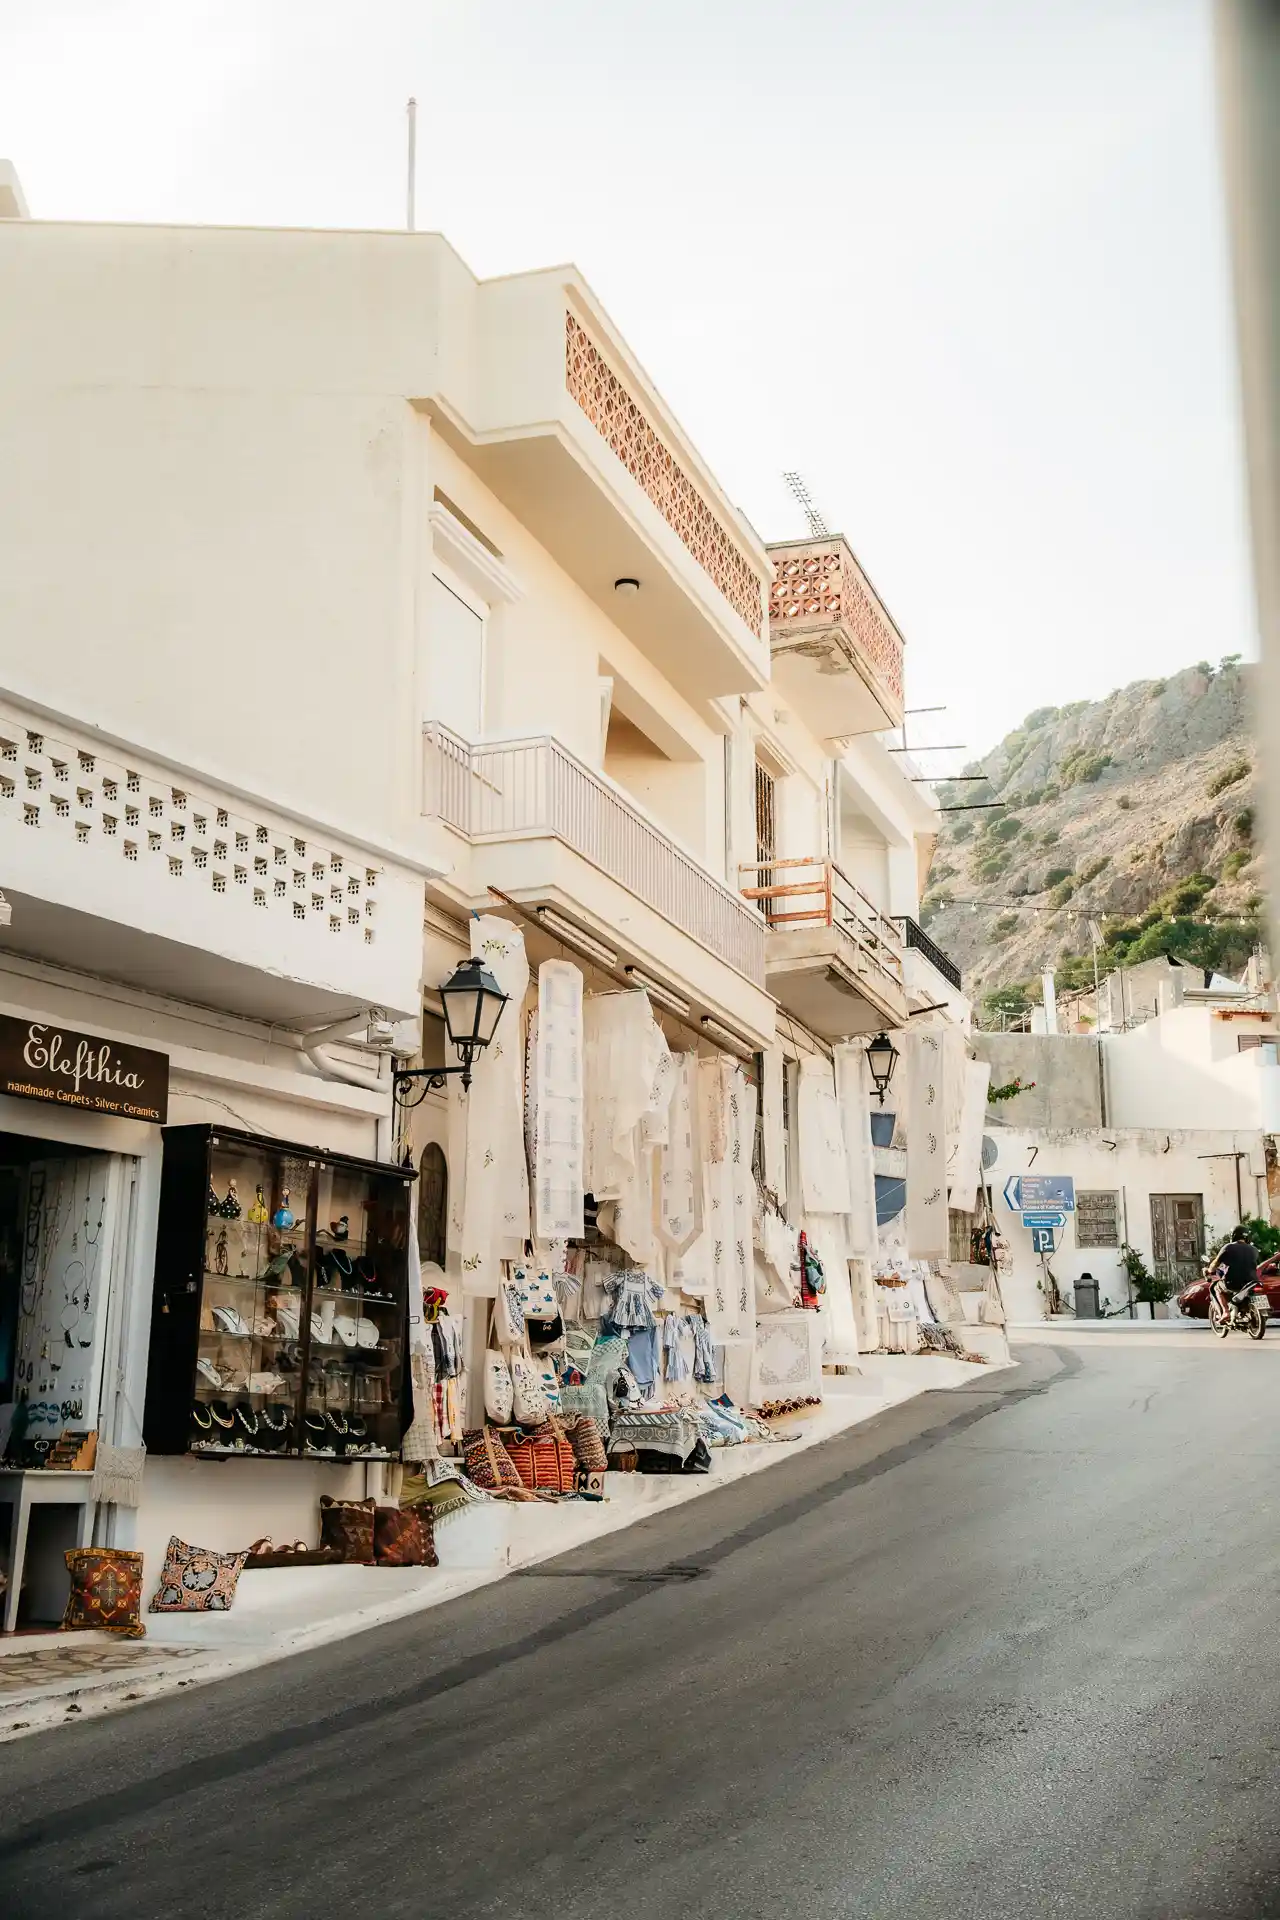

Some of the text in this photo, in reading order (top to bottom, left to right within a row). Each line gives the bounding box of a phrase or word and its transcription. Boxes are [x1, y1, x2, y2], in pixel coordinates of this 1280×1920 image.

[23, 1024, 145, 1092] Elefthia
[56, 1089, 90, 1105] Carpets
[95, 1096, 119, 1111] Silver
[123, 1102, 160, 1119] Ceramics
[1038, 1230, 1050, 1252] P
